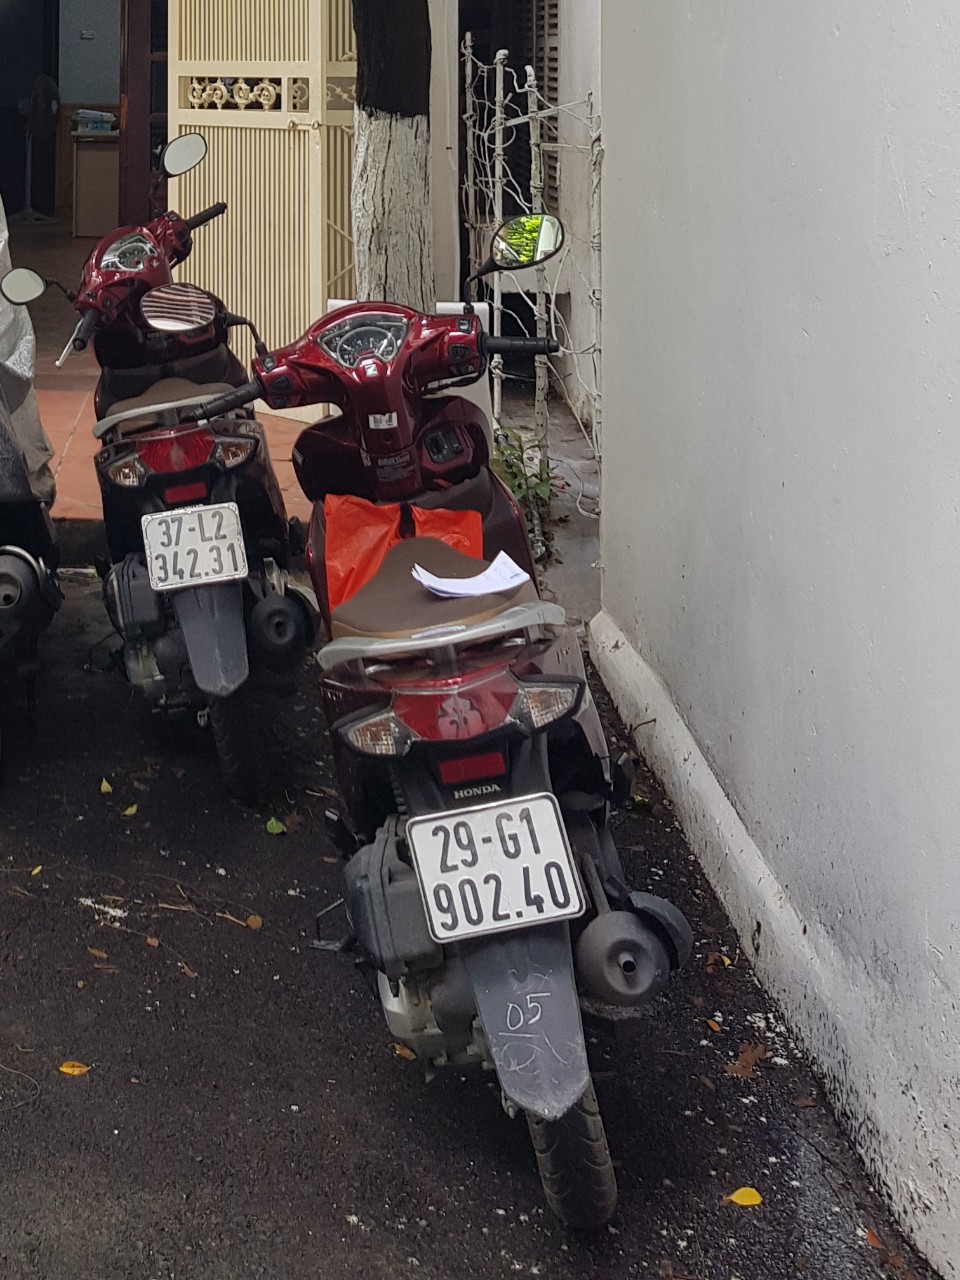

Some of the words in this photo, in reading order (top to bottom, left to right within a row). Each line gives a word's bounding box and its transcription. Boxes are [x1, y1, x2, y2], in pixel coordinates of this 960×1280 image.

[157, 510, 227, 548] 37-L2
[154, 542, 239, 583] 342.31
[453, 783, 502, 800] HONDA
[431, 806, 542, 874] 29-G1
[432, 860, 572, 932] 902.40
